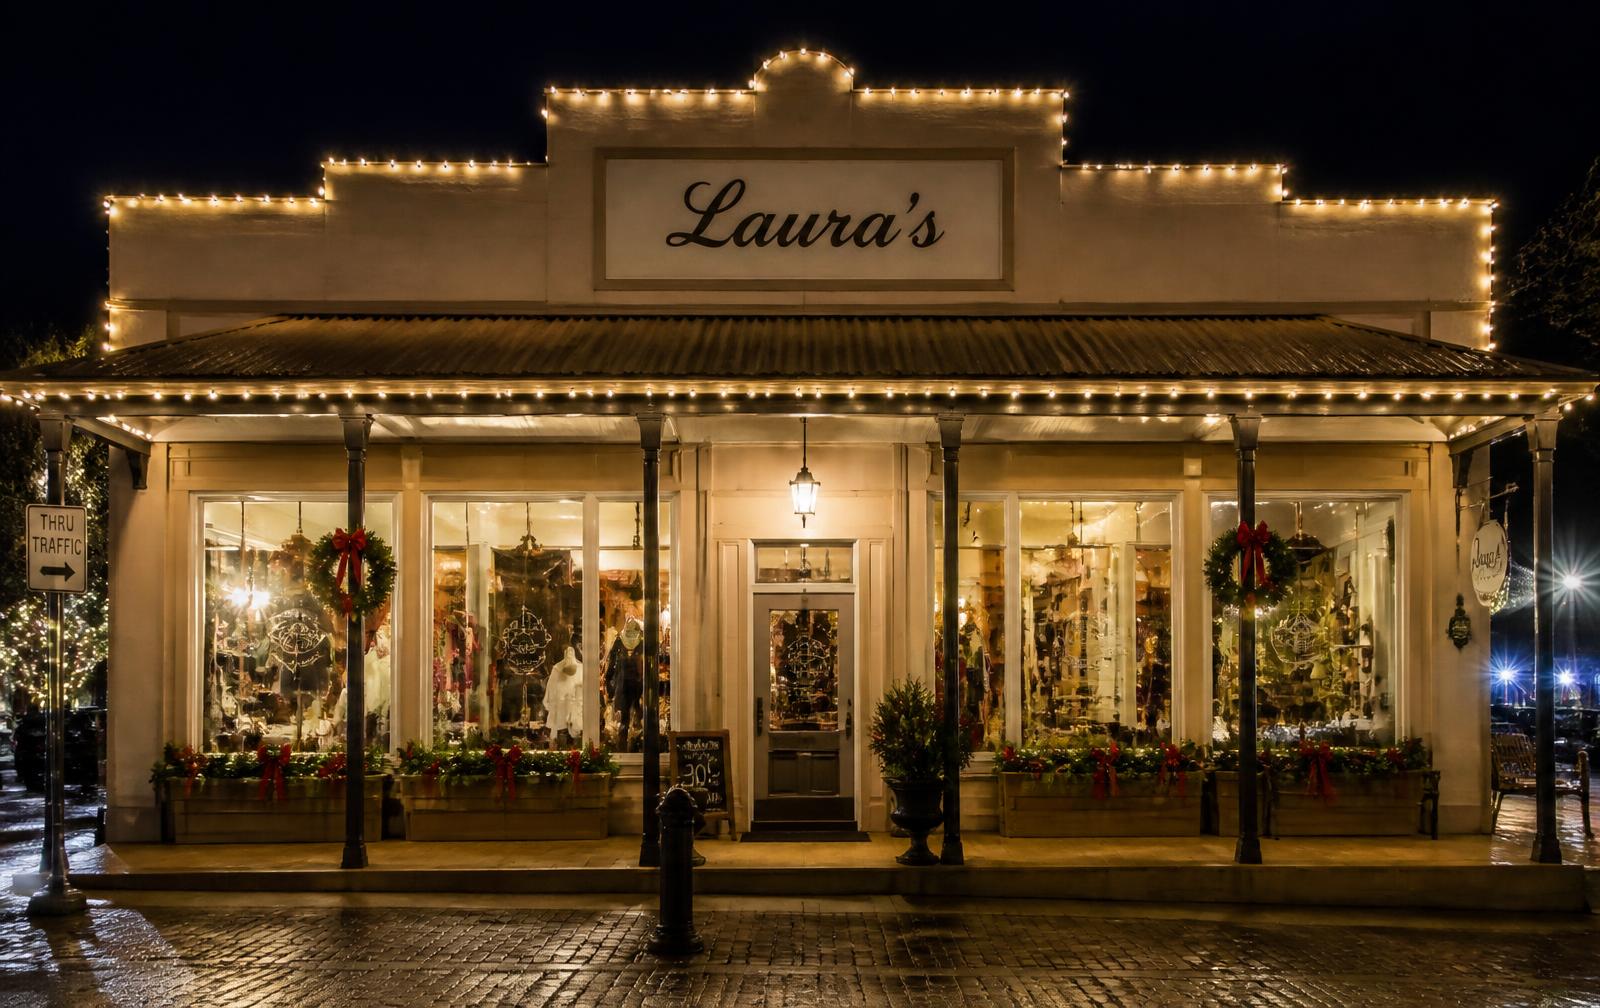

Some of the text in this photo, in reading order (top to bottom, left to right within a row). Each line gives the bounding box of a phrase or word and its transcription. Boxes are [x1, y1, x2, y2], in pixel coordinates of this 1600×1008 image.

[666, 178, 945, 248] Laura's
[41, 514, 74, 532] THRU
[32, 536, 82, 555] TRAFFIC
